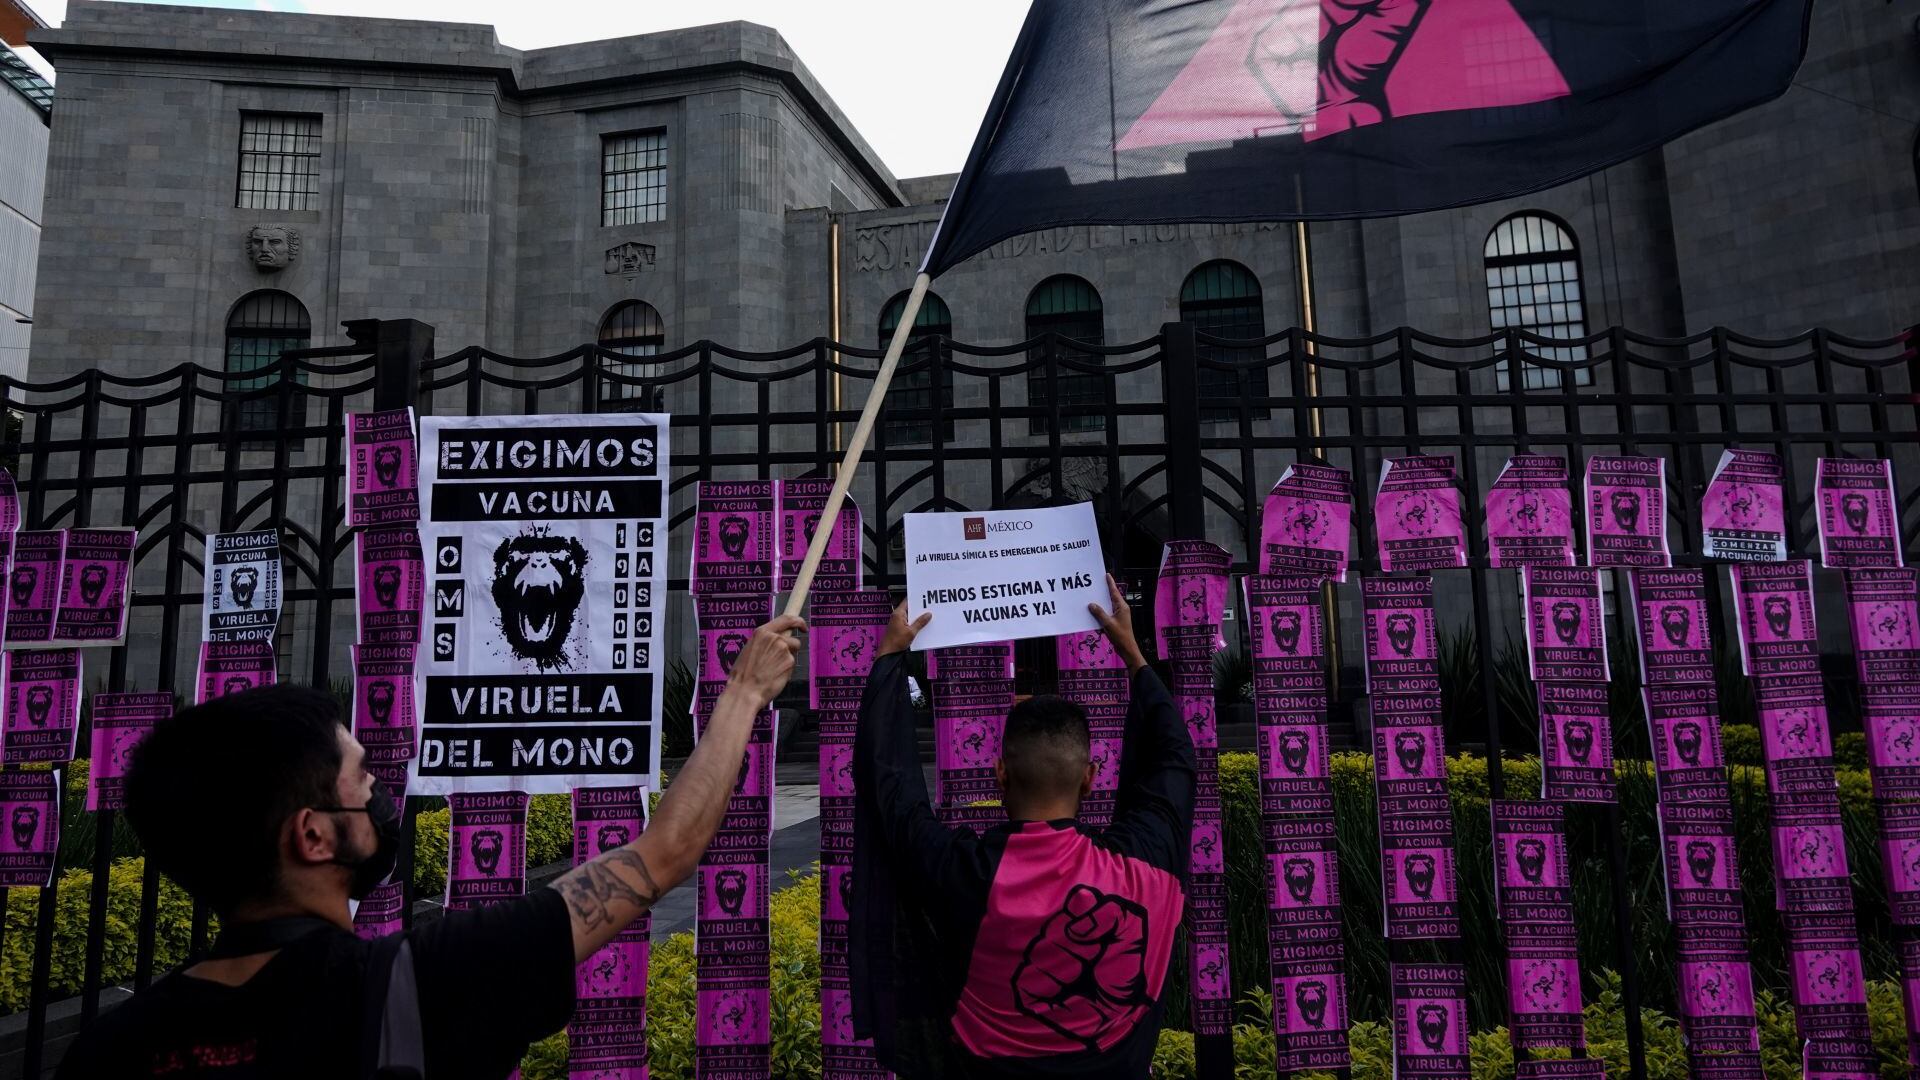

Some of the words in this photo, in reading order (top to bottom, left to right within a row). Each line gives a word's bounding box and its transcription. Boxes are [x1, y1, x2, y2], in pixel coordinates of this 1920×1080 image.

[441, 438, 654, 470] EXIGIMOS
[1592, 459, 1657, 471] EXIGIMOS
[1824, 464, 1884, 474] EXIGIMOS
[1604, 477, 1646, 485] VACUNA
[1833, 479, 1874, 487] VACUNA
[700, 485, 771, 496] EXIGIMOS
[363, 494, 415, 504] VIRUELA
[478, 490, 616, 514] VACUNA
[713, 502, 758, 510] VACUNA
[382, 508, 419, 520] MONO
[968, 524, 982, 533] AHF
[988, 520, 1032, 533] MÉXICO
[70, 534, 130, 545] EXIGIMOS
[216, 534, 278, 548] EXIGIMOS
[1602, 538, 1654, 549] VIRUELA
[1835, 540, 1886, 549] VIRUELA
[1713, 541, 1776, 550] COMENZAR
[79, 551, 118, 559] VACUNA
[226, 552, 268, 561] VACUNA
[916, 555, 927, 564] ¡LA
[930, 553, 960, 561] VIRUELA
[962, 550, 987, 560] SÍMICA
[1001, 546, 1048, 556] EMERGENCIA
[1063, 540, 1090, 550] SALUD!
[1595, 554, 1614, 564] DEL
[1623, 554, 1661, 564] MONO
[1856, 556, 1890, 565] MONO
[706, 565, 762, 575] VIRUELA
[1741, 564, 1805, 576] EXIGIMOS
[1532, 570, 1597, 581] EXIGIMOS
[1639, 573, 1704, 584] EXIGIMOS
[726, 581, 767, 590] MONO
[1253, 579, 1318, 589] EXIGIMOS
[1365, 581, 1432, 592] EXIGIMOS
[1755, 581, 1798, 591] VACUNA
[923, 588, 976, 608] ¡MENOS
[982, 581, 1043, 599] ESTIGMA
[1048, 579, 1056, 592] Y
[1062, 572, 1092, 590] MÁS
[1544, 588, 1589, 596] VACUNA
[1652, 590, 1696, 599] VACUNA
[1264, 596, 1310, 604] VACUNA
[1379, 599, 1424, 607] VACUNA
[700, 601, 768, 612] EXIGIMOS
[963, 604, 1028, 623] VACUNAS
[1034, 601, 1056, 615] YA!
[218, 614, 268, 625] VIRUELA
[711, 619, 757, 627] VACUNA
[77, 626, 113, 637] MONO
[1758, 644, 1810, 654] VIRUELA
[13, 654, 75, 666] EXIGIMOS
[1544, 650, 1597, 660] VIRUELA
[1654, 654, 1707, 663] VIRUELA
[220, 661, 261, 670] VACUNA
[363, 664, 405, 674] VACUNA
[1263, 659, 1317, 670] VIRUELA
[1378, 663, 1433, 673] VIRUELA
[1779, 660, 1816, 670] MONO
[23, 671, 62, 679] VACUNA
[1562, 667, 1602, 677] MONO
[1675, 669, 1713, 680] MONO
[1283, 677, 1323, 687] MONO
[1399, 679, 1439, 689] MONO
[451, 686, 622, 714] VIRUELA
[1652, 689, 1717, 701] EXIGIMOS
[1259, 697, 1327, 708] EXIGIMOS
[1374, 698, 1441, 709] EXIGIMOS
[1556, 705, 1600, 714] VACUNA
[1664, 706, 1708, 716] VACUNA
[1272, 715, 1317, 724] VACUNA
[1386, 716, 1433, 725] VACUNA
[14, 734, 61, 743] VIRUELA
[29, 748, 65, 759] MONO
[372, 748, 410, 760] MONO
[422, 739, 494, 768] DEL
[512, 737, 634, 767] MONO
[1554, 770, 1608, 782] VIRUELA
[1669, 771, 1721, 782] VIRUELA
[1269, 781, 1326, 792] VIRUELA
[1387, 782, 1443, 793] VIRUELA
[9, 791, 48, 799] VACUNA
[1574, 788, 1614, 798] MONO
[1687, 788, 1728, 798] MONO
[454, 795, 525, 809] EXIGIMOS
[1291, 799, 1330, 809] MONO
[1407, 800, 1448, 810] MONO
[591, 808, 639, 818] VACUNA
[1496, 805, 1564, 816] EXIGIMOS
[1667, 807, 1732, 819] EXIGIMOS
[465, 813, 513, 824] VACUNA
[727, 818, 767, 827] MONO
[1265, 822, 1333, 834] EXIGIMOS
[1383, 820, 1452, 831] EXIGIMOS
[1508, 823, 1554, 832] VACUNA
[1679, 825, 1724, 835] VACUNA
[1277, 841, 1323, 850] VACUNA
[1396, 838, 1444, 847] VACUNA
[709, 854, 756, 863] VACUNA
[15, 872, 48, 883] MONO
[457, 883, 515, 894] VIRUELA
[1504, 891, 1562, 901] VIRUELA
[1679, 892, 1732, 902] VIRUELA
[1275, 911, 1333, 922] VIRUELA
[1396, 906, 1452, 917] VIRUELA
[1527, 908, 1567, 918] MONO
[1696, 909, 1738, 920] MONO
[702, 923, 760, 933] VIRUELA
[1417, 924, 1458, 934] MONO
[1517, 926, 1530, 934] LA
[1298, 928, 1338, 939] MONO
[725, 941, 765, 950] MONO
[1273, 944, 1344, 959] EXIGIMOS
[1287, 964, 1334, 974] VACUNA
[1397, 969, 1464, 980] EXIGIMOS
[1409, 988, 1456, 997] VACUNA
[1287, 1034, 1345, 1047] VIRUELA
[1280, 1055, 1304, 1066] DEL
[1406, 1058, 1464, 1070] VIRUELA
[1823, 1062, 1867, 1071] VACUNA
